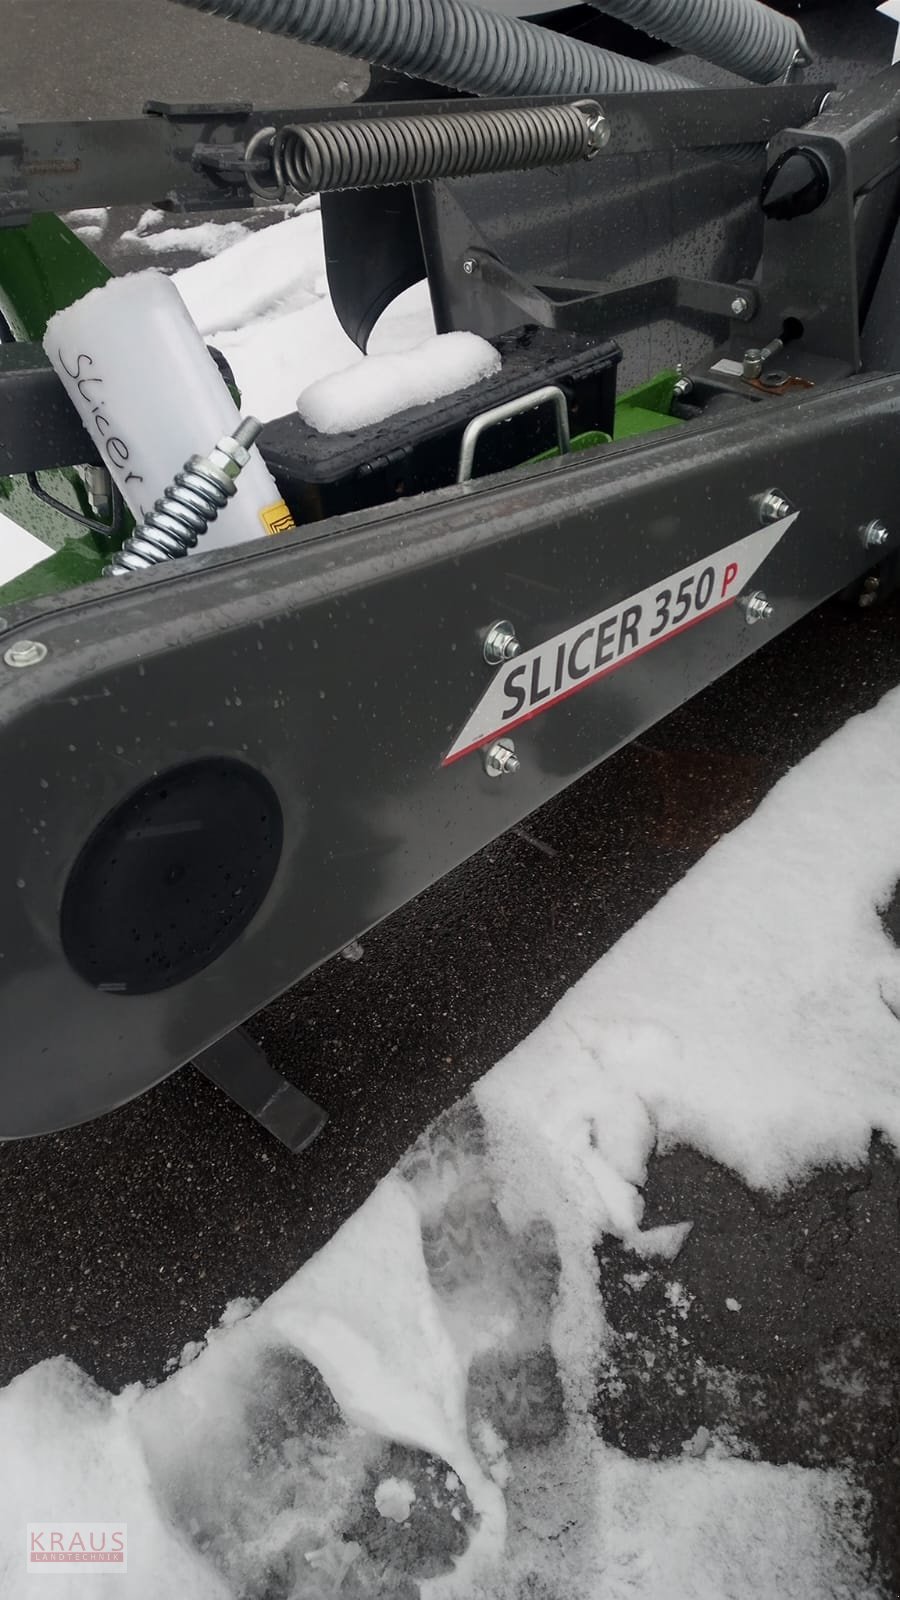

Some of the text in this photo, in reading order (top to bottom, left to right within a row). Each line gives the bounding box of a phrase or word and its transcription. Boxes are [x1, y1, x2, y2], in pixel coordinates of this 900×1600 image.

[501, 562, 738, 720] SLICER 350 P
